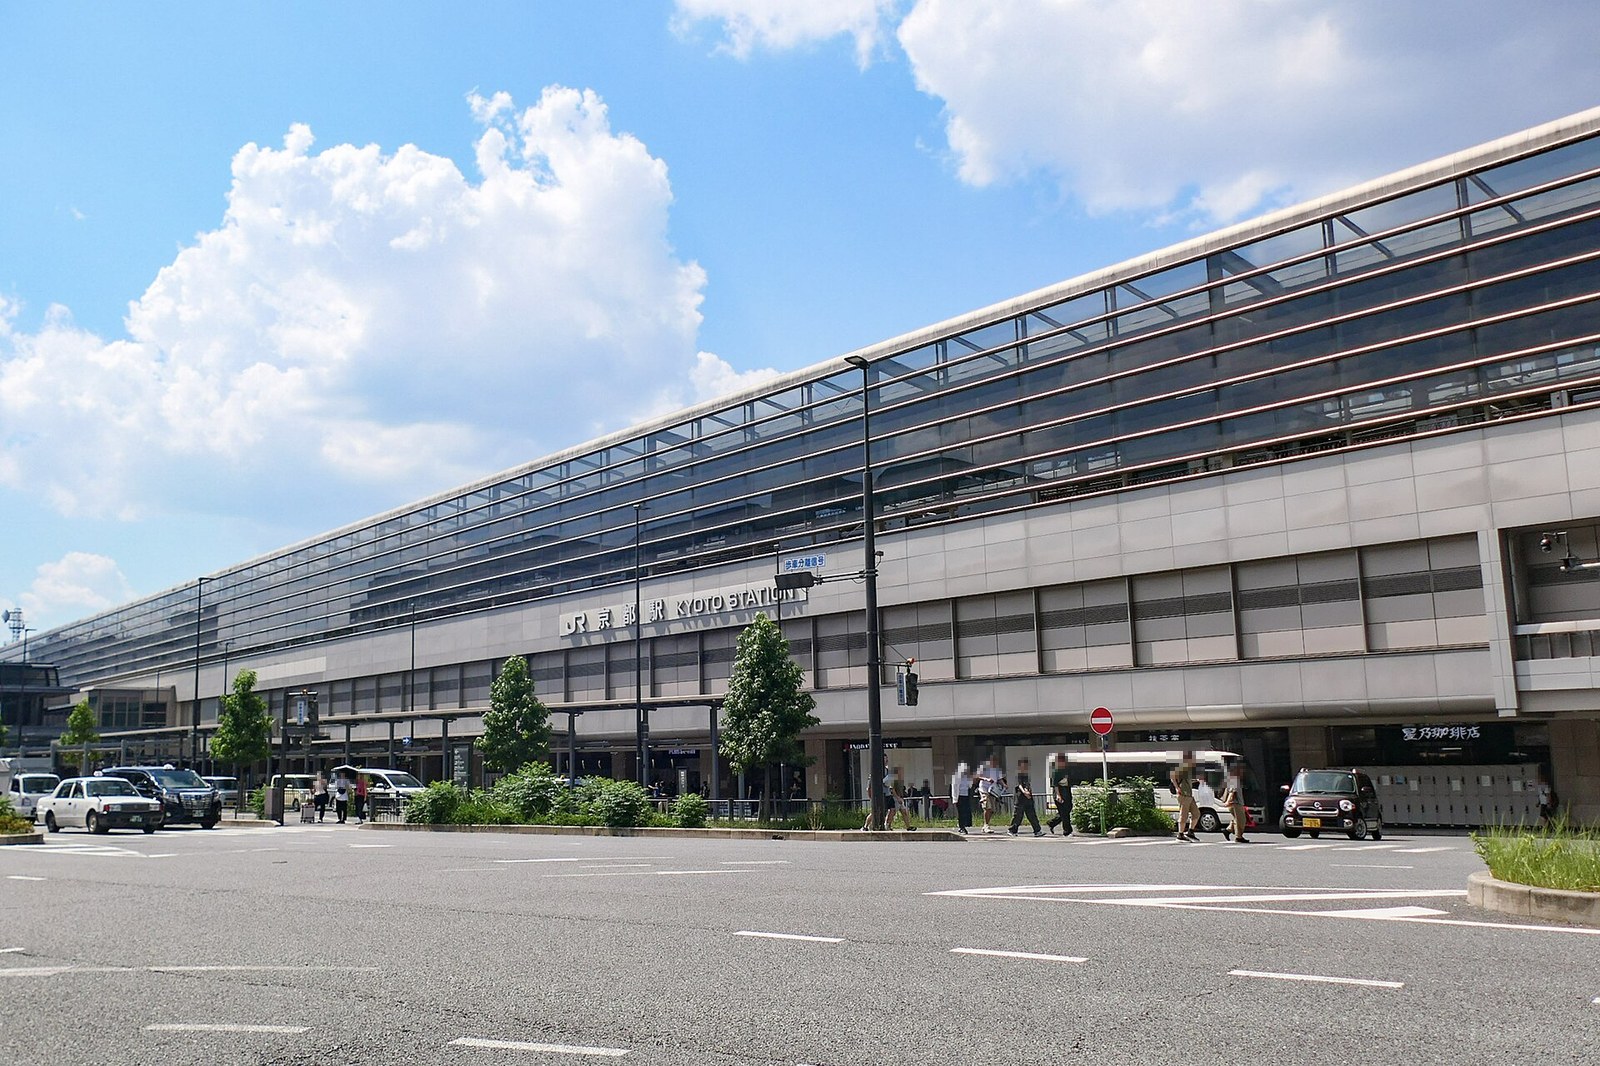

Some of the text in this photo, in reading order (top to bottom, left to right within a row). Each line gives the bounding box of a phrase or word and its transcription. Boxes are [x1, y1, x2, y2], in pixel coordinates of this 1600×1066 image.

[566, 612, 587, 634] JR
[598, 598, 664, 630] 京都駅
[676, 594, 724, 616] KYOTO
[1402, 726, 1480, 740] 星乃珈琲店
